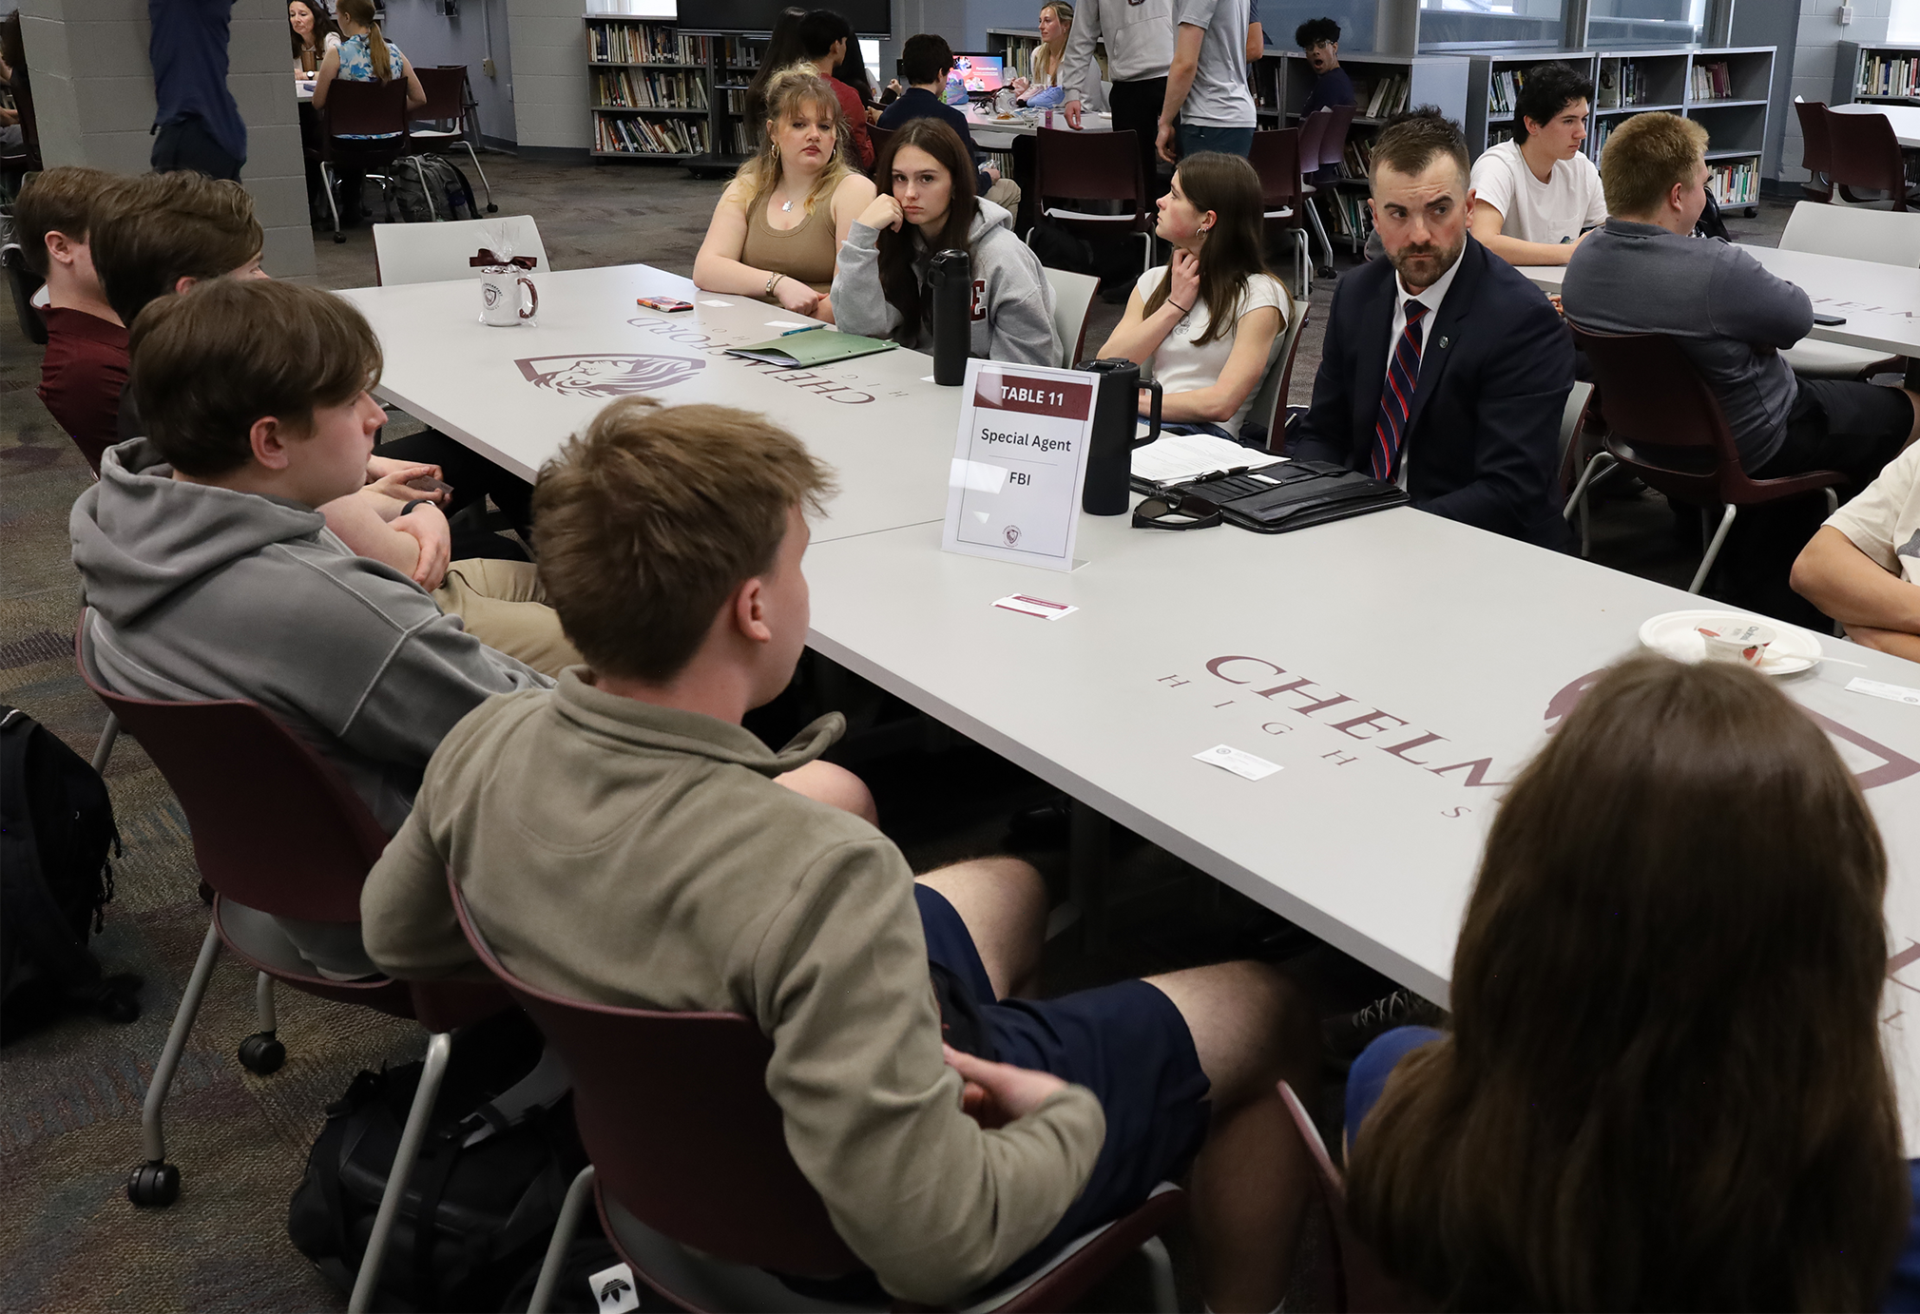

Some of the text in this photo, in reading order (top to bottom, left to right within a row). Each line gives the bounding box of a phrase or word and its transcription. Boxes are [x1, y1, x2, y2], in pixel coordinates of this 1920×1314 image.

[1000, 386, 1064, 406] TABLE 11
[980, 428, 1072, 452] Special Agent
[1009, 471, 1031, 486] FBI
